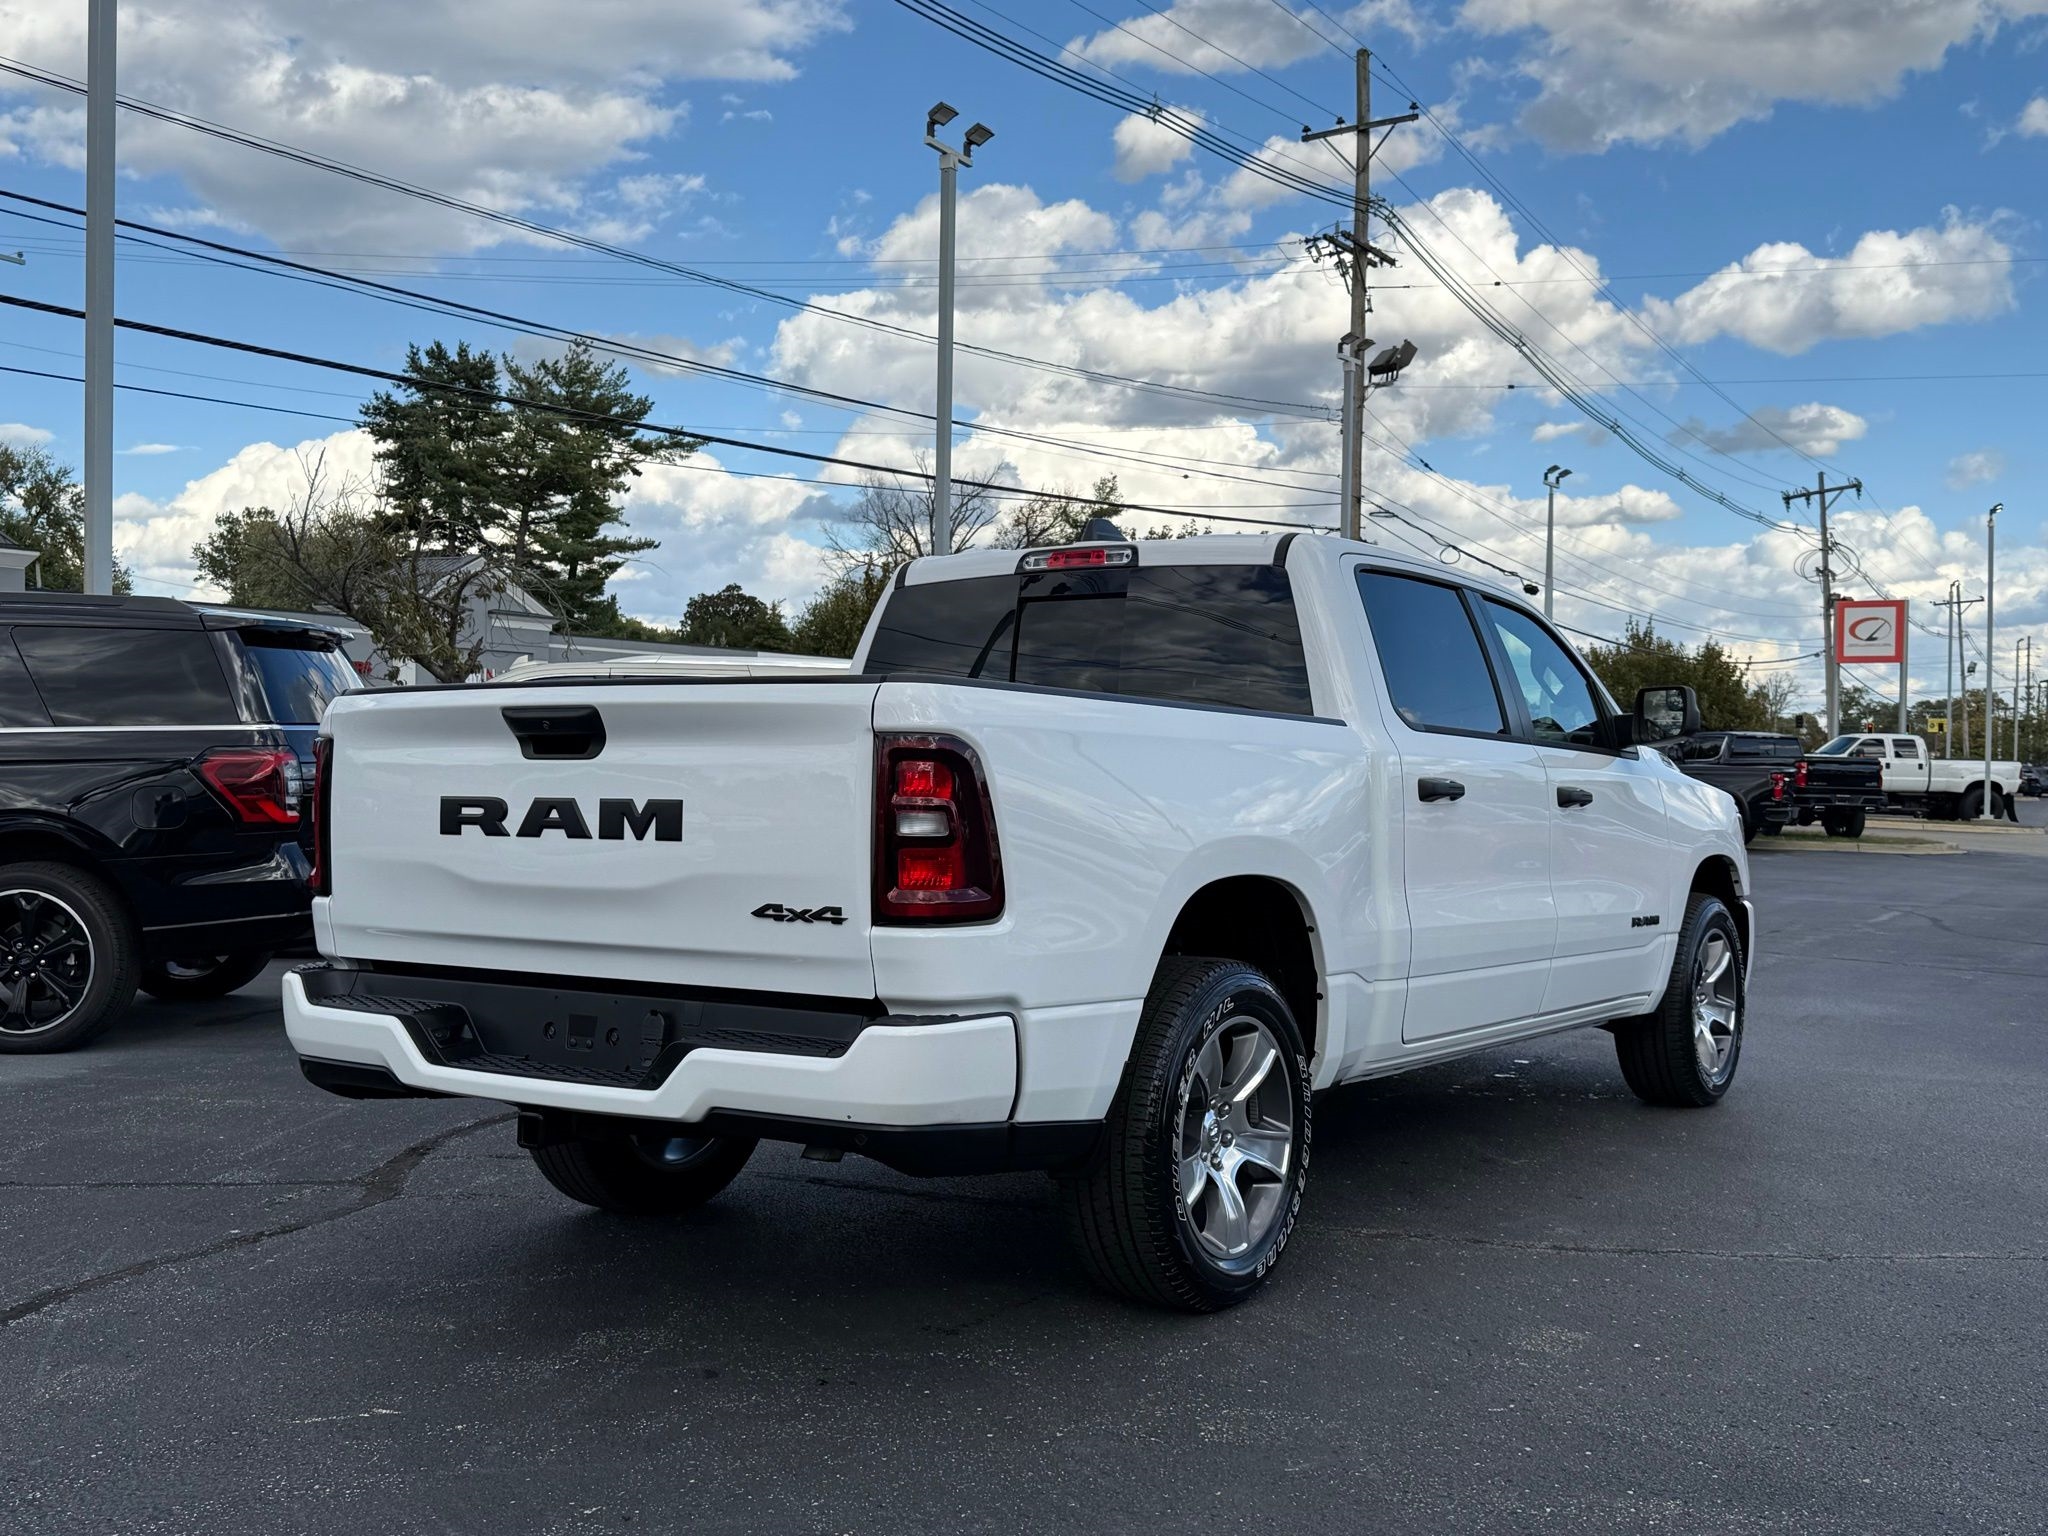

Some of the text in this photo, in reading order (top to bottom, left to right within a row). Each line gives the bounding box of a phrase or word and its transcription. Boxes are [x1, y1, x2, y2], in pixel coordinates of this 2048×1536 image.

[440, 795, 684, 842] RAM
[750, 903, 849, 925] 4x4
[1255, 1053, 1314, 1279] BRIDGESTONE
